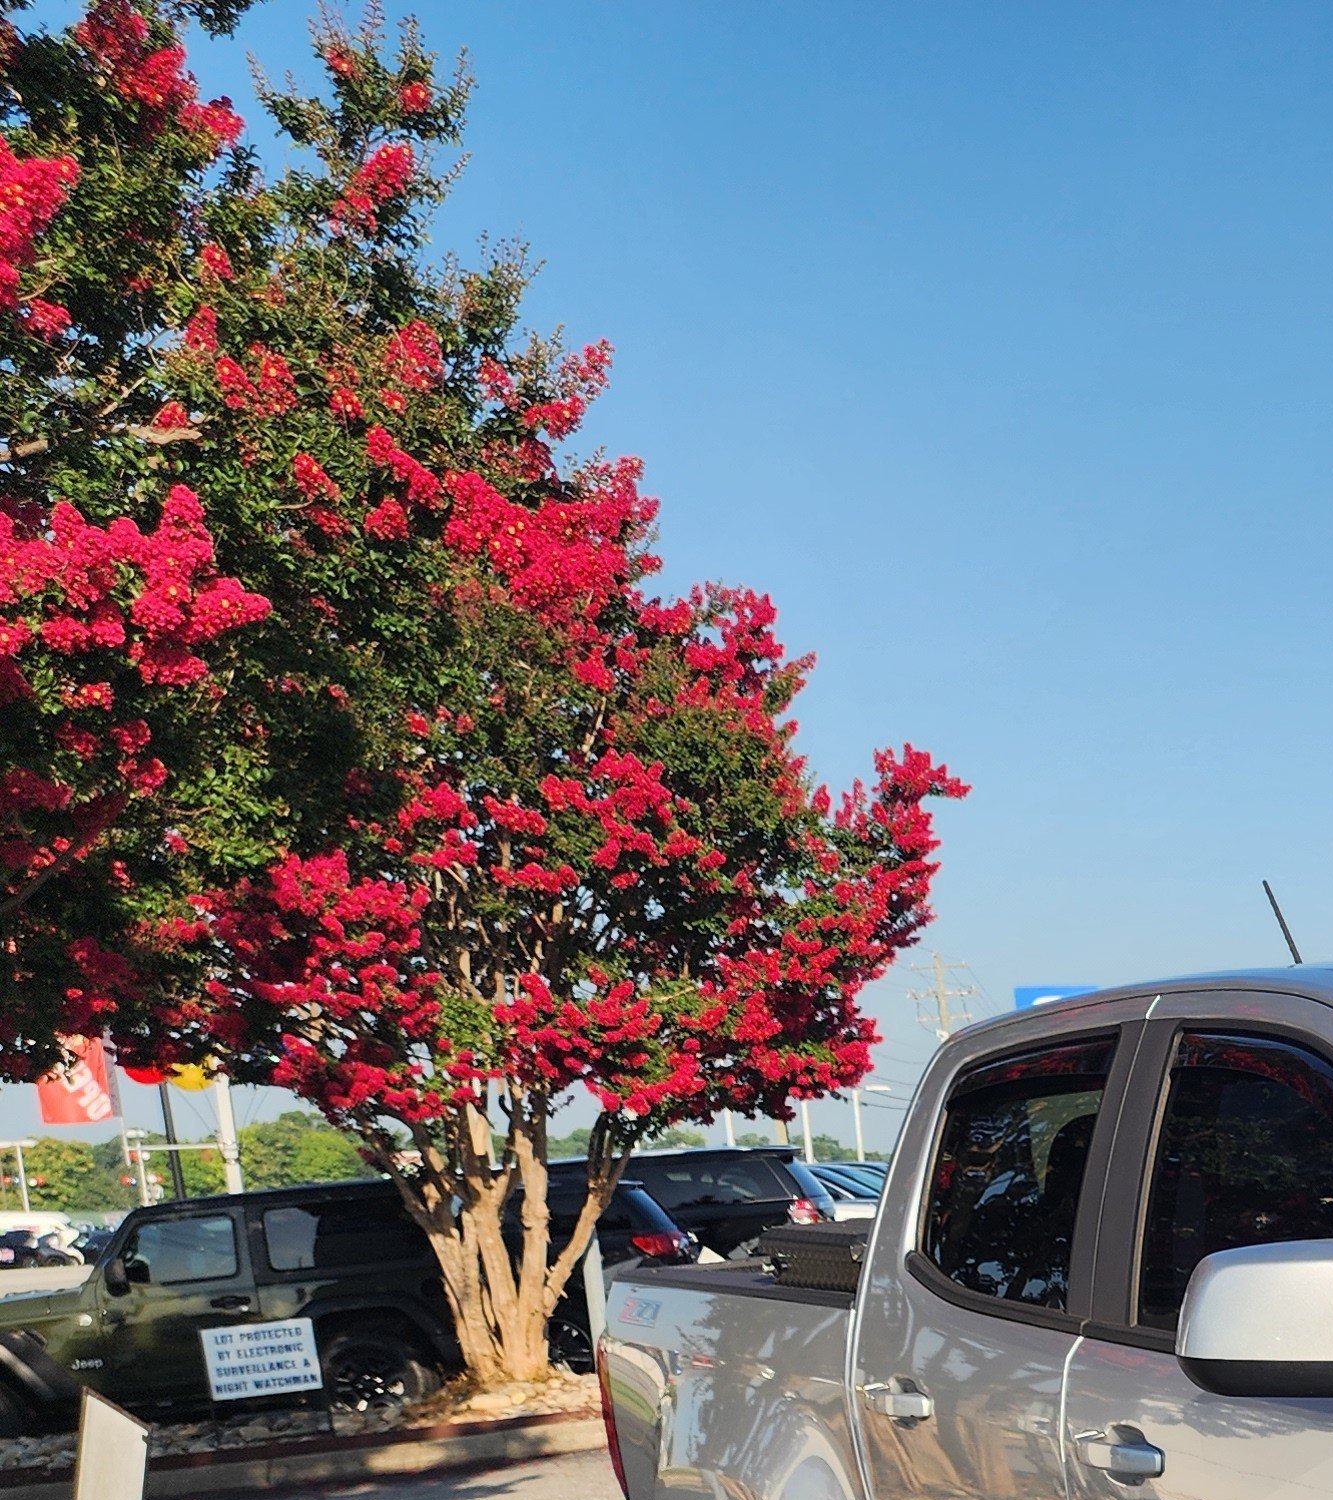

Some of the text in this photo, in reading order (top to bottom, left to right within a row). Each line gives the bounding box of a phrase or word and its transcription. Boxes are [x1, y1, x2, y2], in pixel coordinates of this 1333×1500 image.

[214, 1327, 302, 1345] LOT PROTECTED
[217, 1342, 304, 1361] BY ELECTRONIC
[71, 1358, 104, 1370] Jeep
[215, 1360, 297, 1378] SURVEILLANCE
[215, 1373, 318, 1394] NIGHT WATCHMAN
